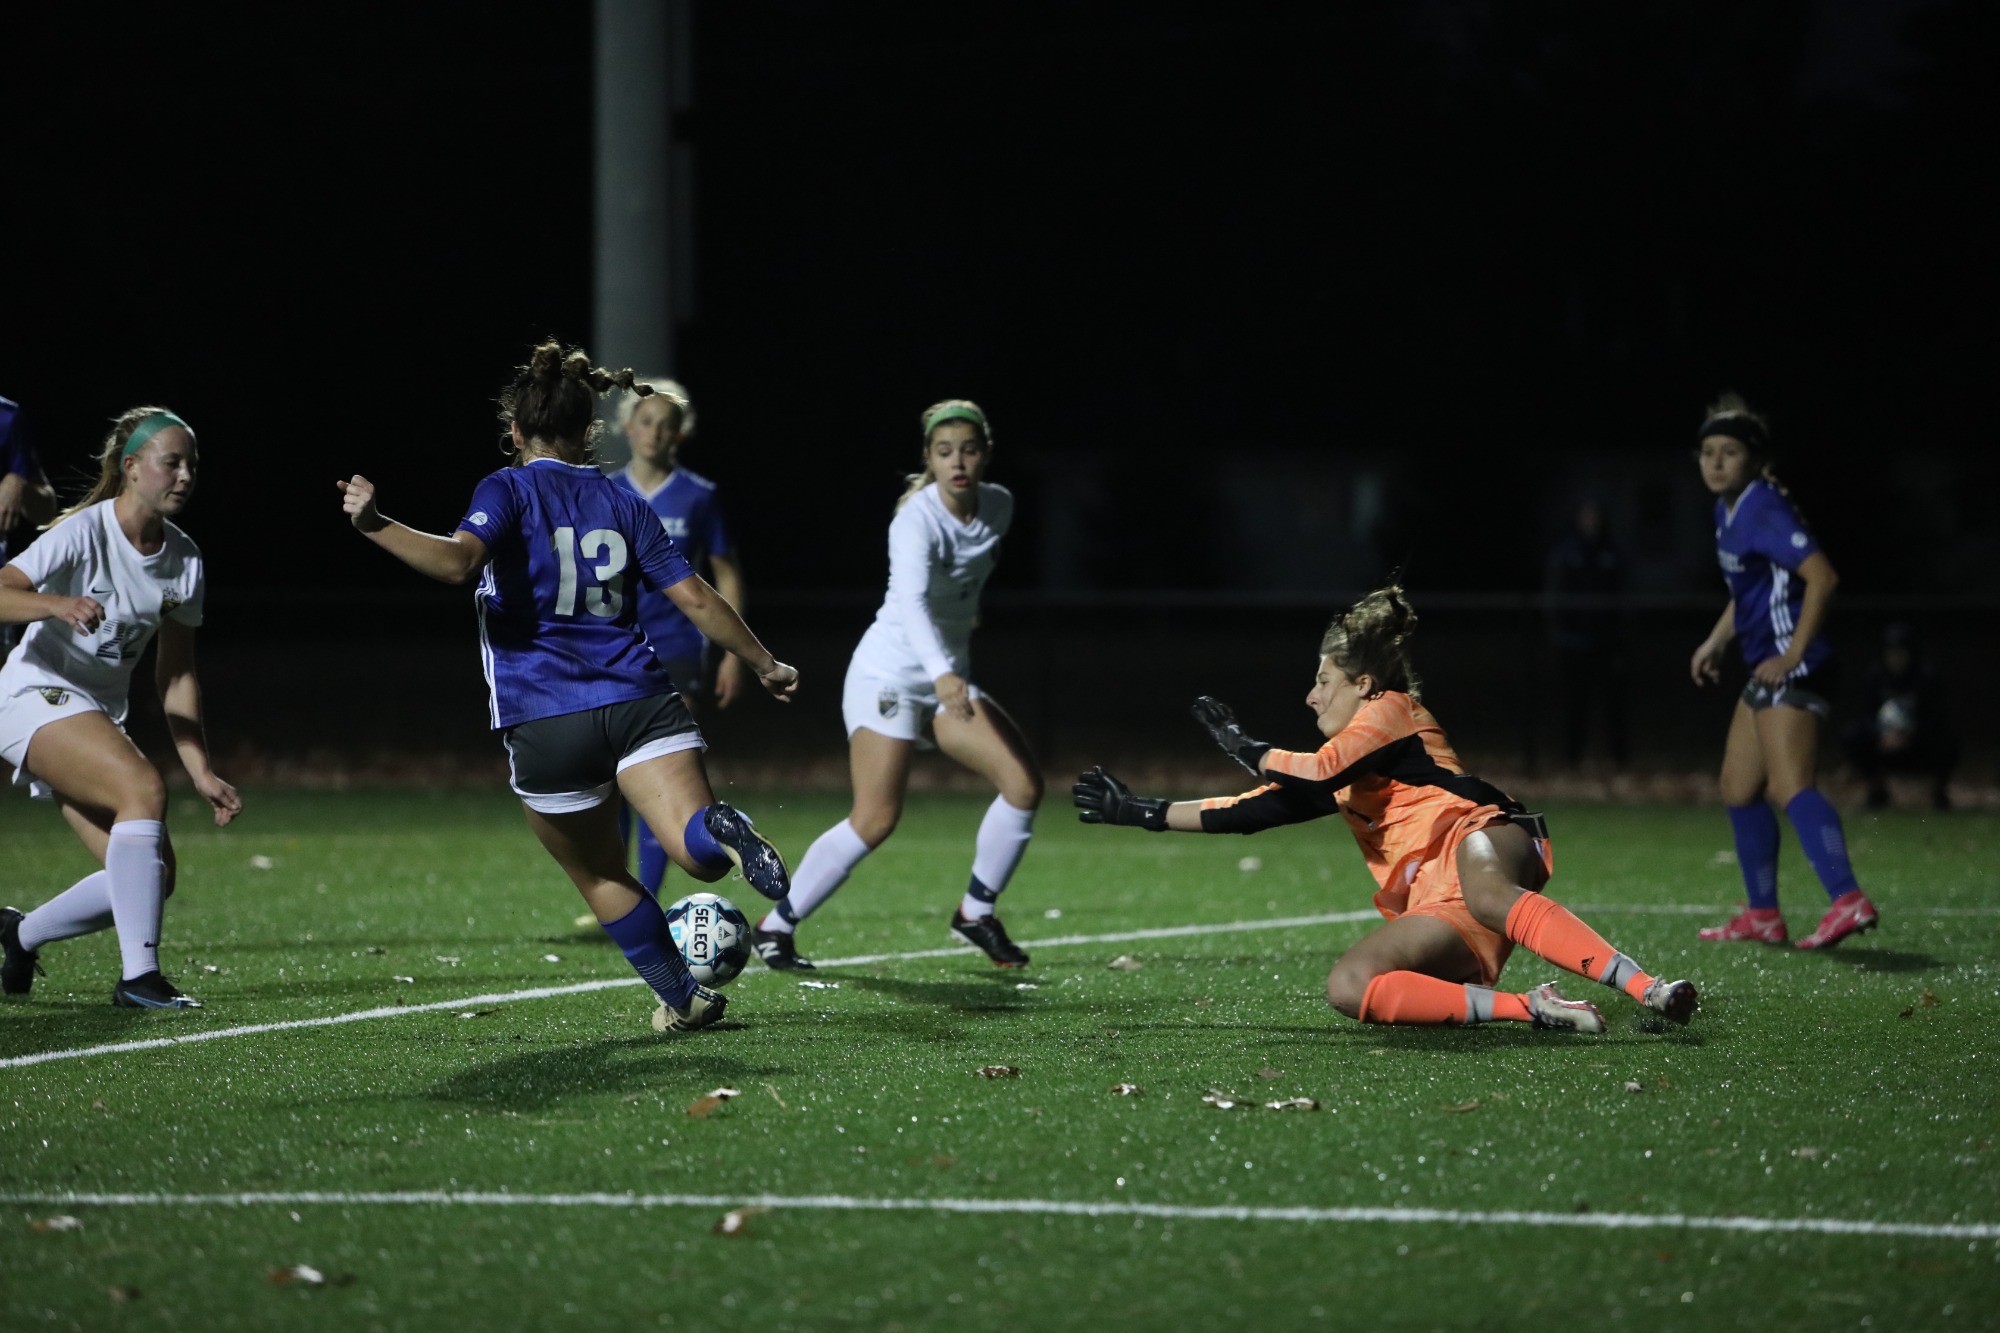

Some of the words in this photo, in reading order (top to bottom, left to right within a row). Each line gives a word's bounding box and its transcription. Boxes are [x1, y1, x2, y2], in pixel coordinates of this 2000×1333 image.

[550, 526, 628, 618] 13
[96, 620, 151, 660] 22
[693, 908, 709, 960] SELECT
